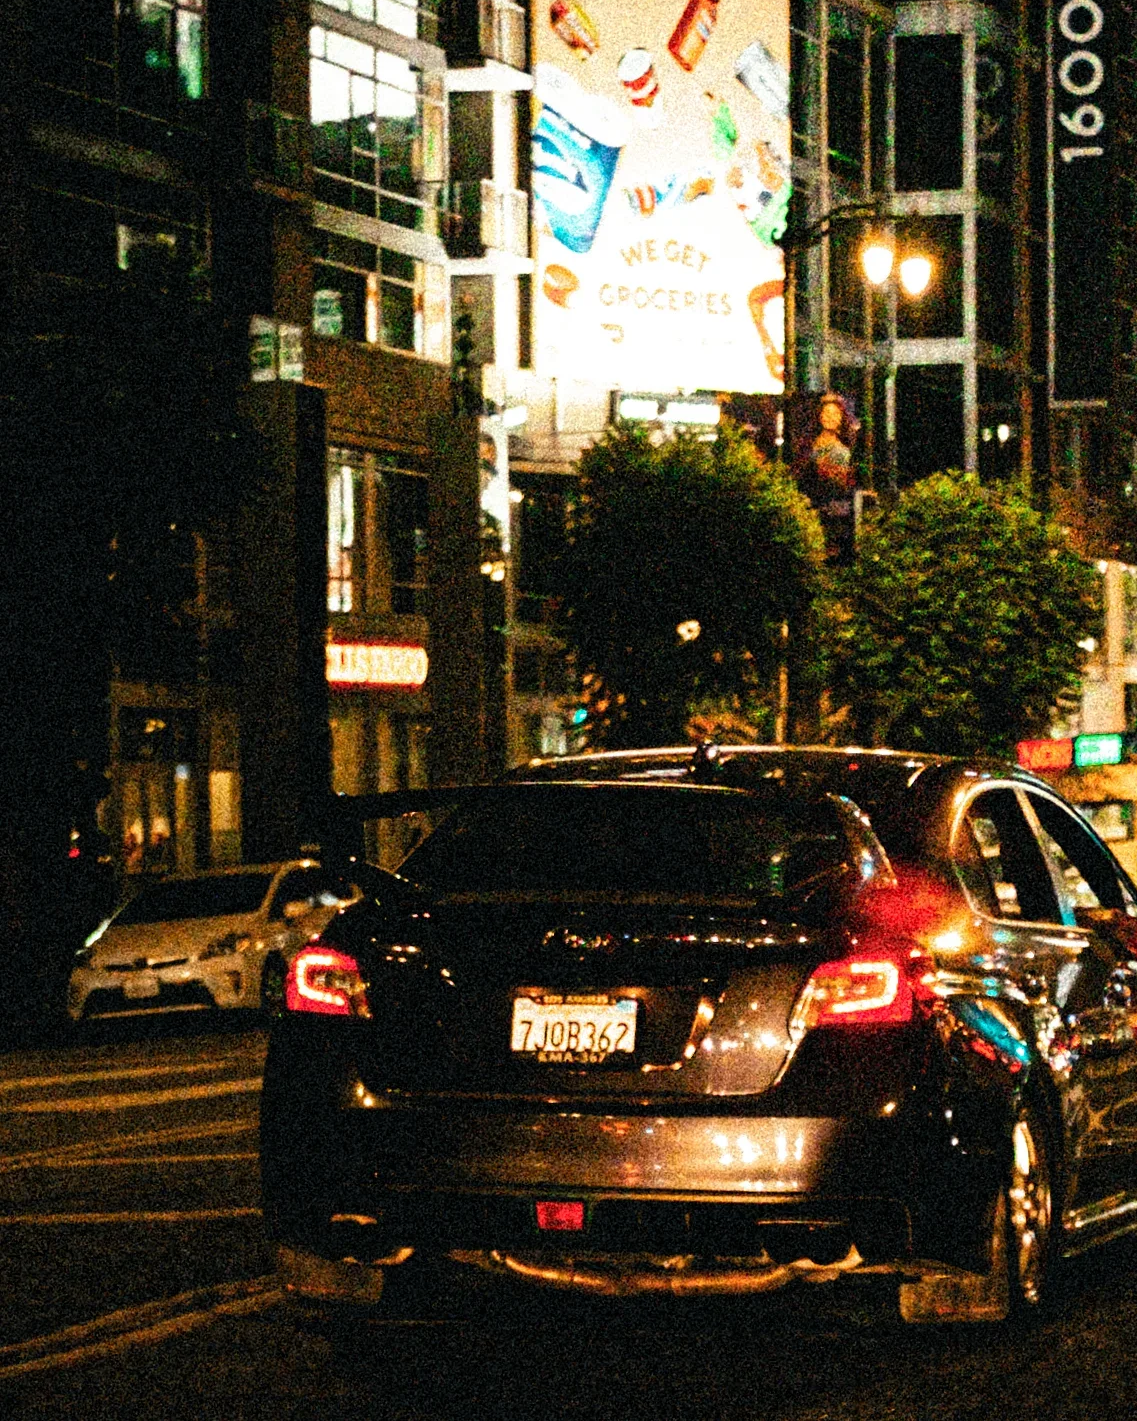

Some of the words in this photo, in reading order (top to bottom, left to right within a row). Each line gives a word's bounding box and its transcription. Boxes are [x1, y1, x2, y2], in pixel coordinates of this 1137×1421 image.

[618, 238, 660, 268] WE
[663, 238, 713, 273] GET
[598, 282, 733, 318] GROCERIES
